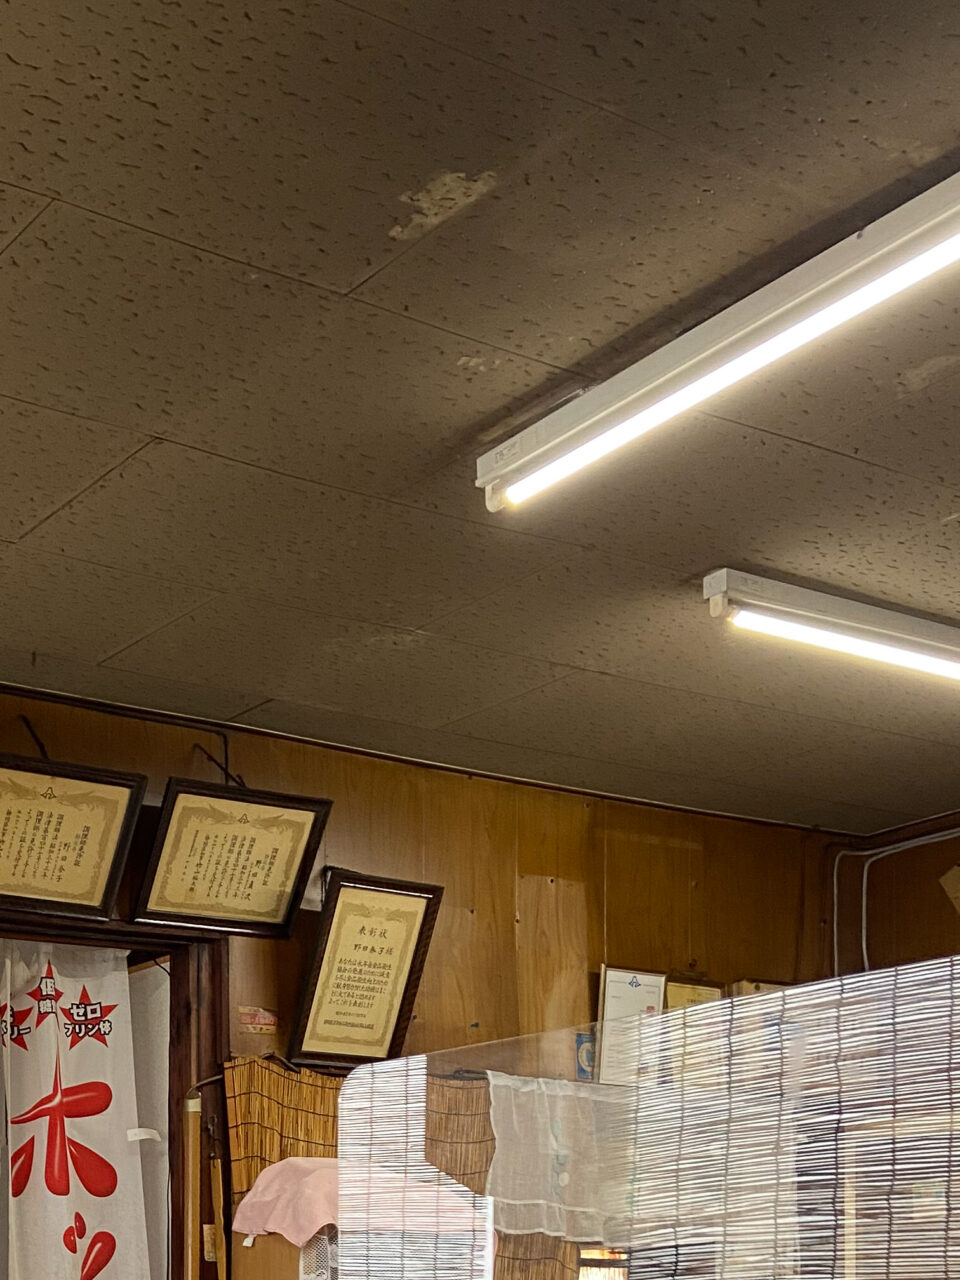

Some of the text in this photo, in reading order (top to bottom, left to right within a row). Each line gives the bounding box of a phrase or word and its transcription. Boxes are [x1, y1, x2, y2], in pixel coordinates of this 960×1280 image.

[69, 1002, 102, 1021] ゼロ
[64, 1020, 112, 1038] プリン体
